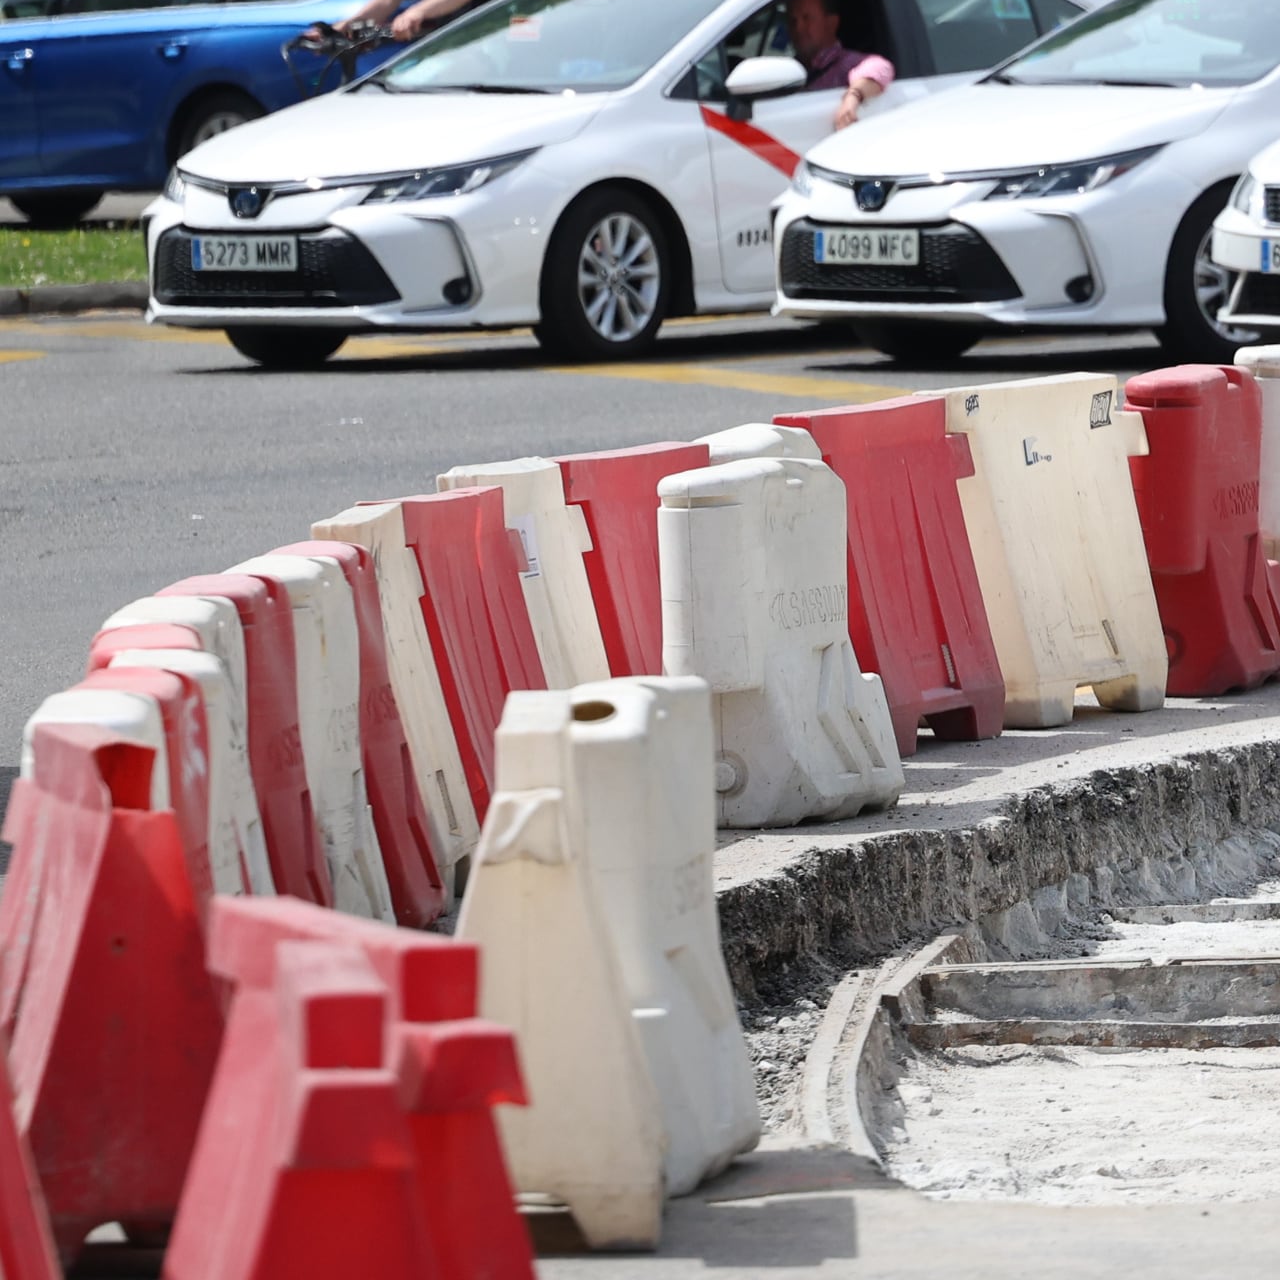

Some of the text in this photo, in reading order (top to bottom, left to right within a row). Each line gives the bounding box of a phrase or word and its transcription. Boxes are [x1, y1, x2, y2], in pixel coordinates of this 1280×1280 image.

[204, 240, 291, 266] 5273 MMR
[826, 233, 913, 260] 4099 MFC
